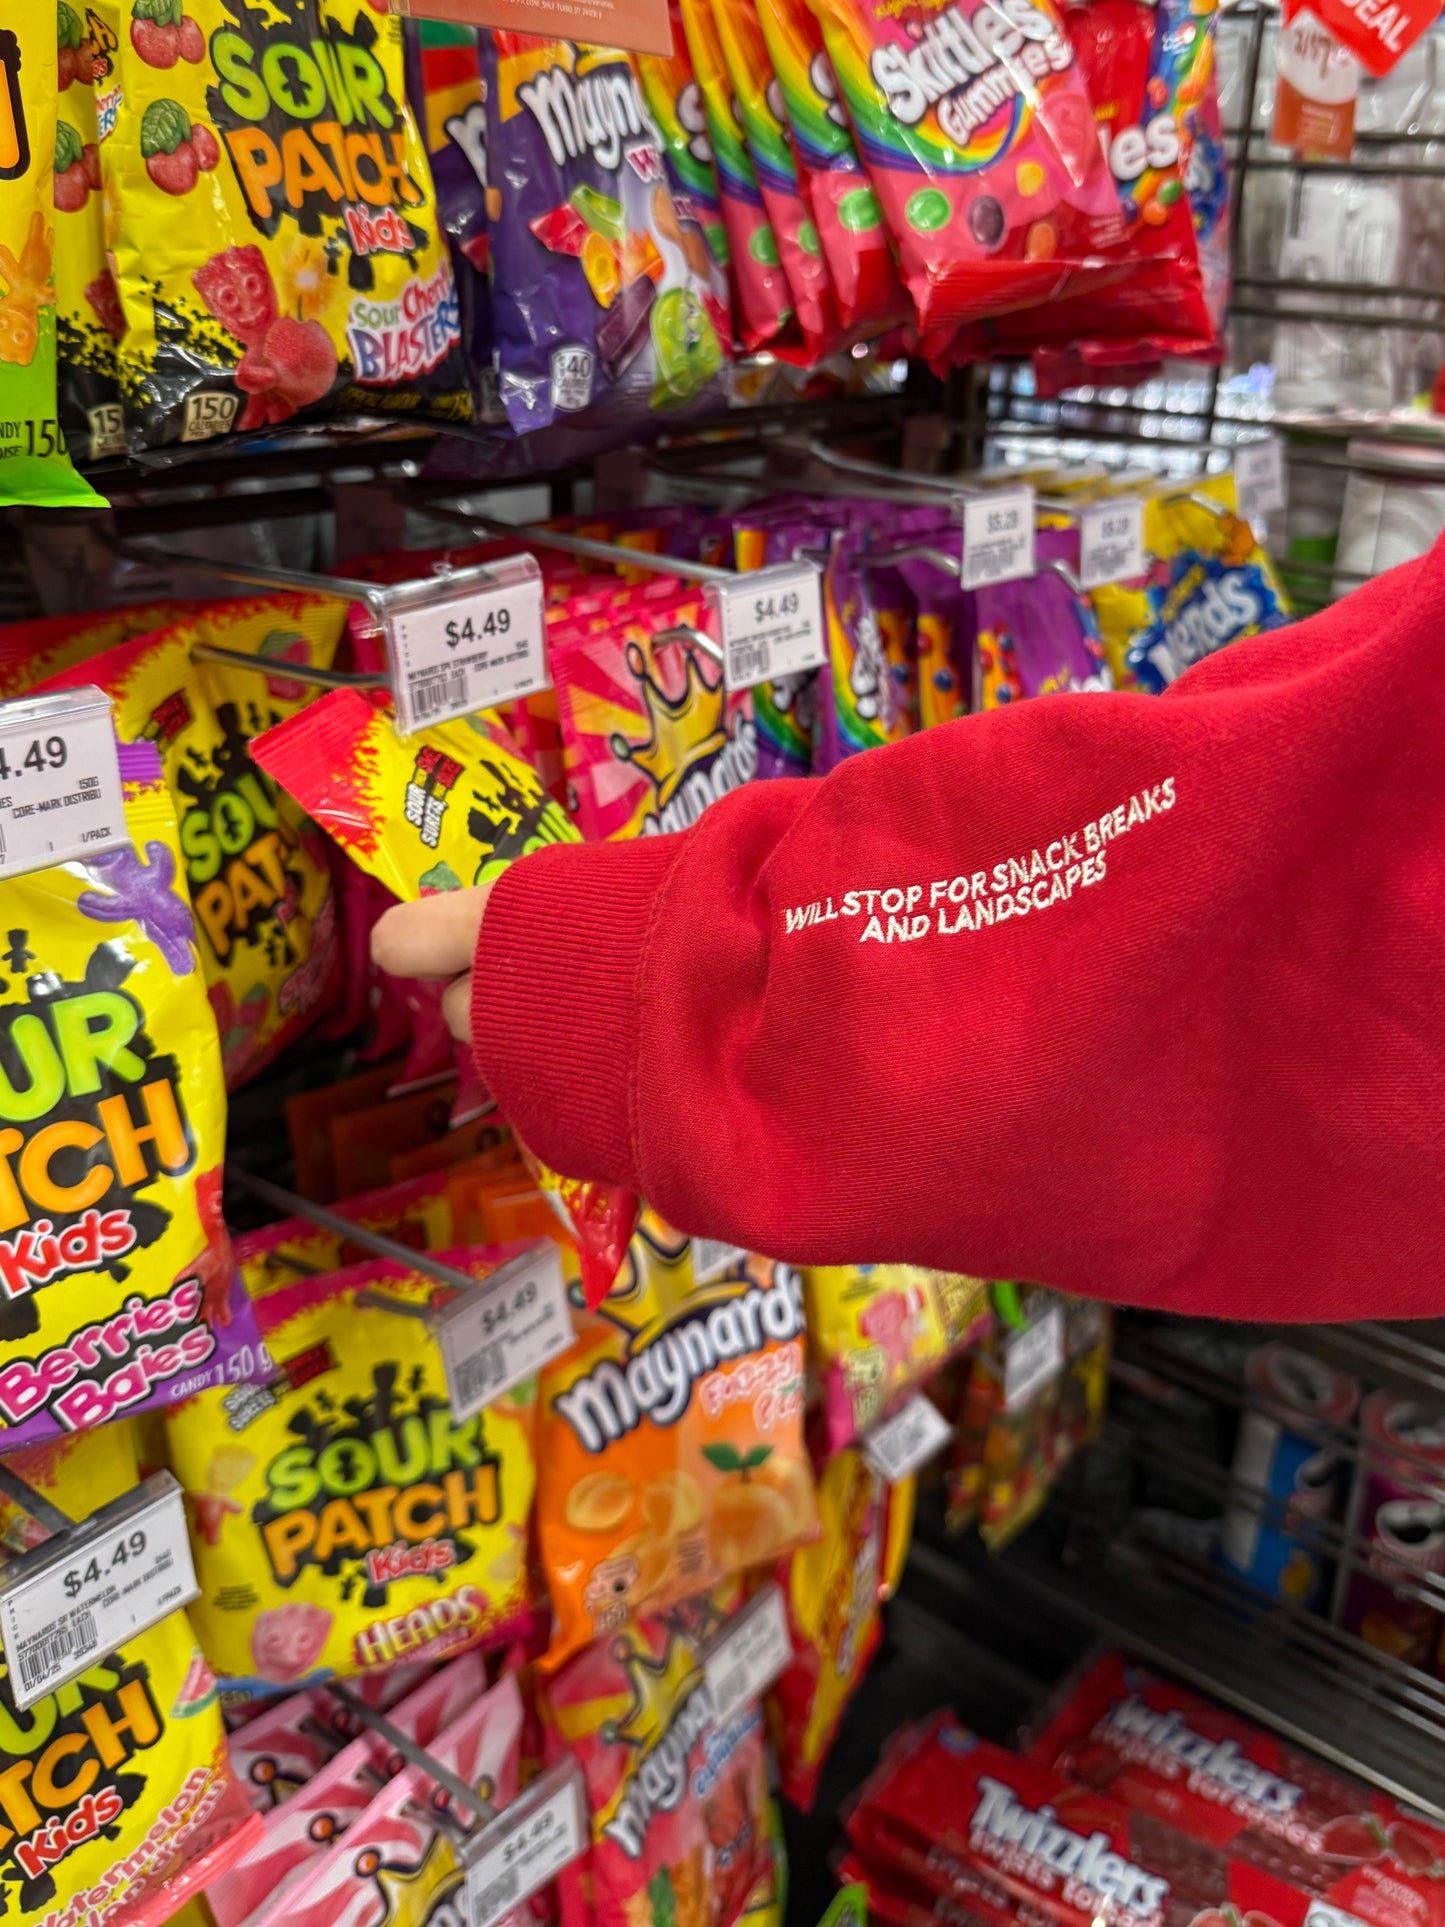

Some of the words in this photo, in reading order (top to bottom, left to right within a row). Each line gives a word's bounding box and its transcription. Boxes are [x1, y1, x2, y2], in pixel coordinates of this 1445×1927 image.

[872, 0, 1054, 124] Skittles
[1341, 0, 1411, 53] EAL
[211, 31, 394, 128] SOUR
[937, 40, 1074, 147] Gummies
[225, 122, 424, 219] PATCH
[345, 204, 415, 256] Kids
[354, 302, 400, 329] Sour
[192, 396, 236, 420] 150
[445, 608, 510, 651] $4.49
[13, 798, 62, 819] CORE-MARK
[405, 782, 427, 827] SOUR
[196, 831, 290, 956] PAT
[785, 897, 839, 934] WILL
[840, 885, 922, 917] STOP
[929, 871, 988, 906] FOR
[990, 834, 1083, 893] SNACK
[1084, 776, 1176, 855] BREAKS
[860, 915, 930, 944] AND
[937, 850, 1108, 935] LANDSCAPES
[0, 1209, 137, 1298] Kids
[0, 1278, 203, 1422] Berries
[55, 1325, 215, 1431] Baies
[170, 1374, 212, 1399] CANDY
[214, 1344, 256, 1386] 150
[268, 1408, 483, 1512] SOUR
[64, 1530, 147, 1598] $4.49
[263, 1465, 498, 1577] PATCH
[366, 1538, 456, 1586] Kids
[16, 1622, 57, 1652] MAYNARDS
[358, 1584, 482, 1664] HEADS
[0, 1679, 160, 1850] TCH
[14, 1785, 123, 1880] Kids
[969, 1777, 1170, 1918] Twizzlers
